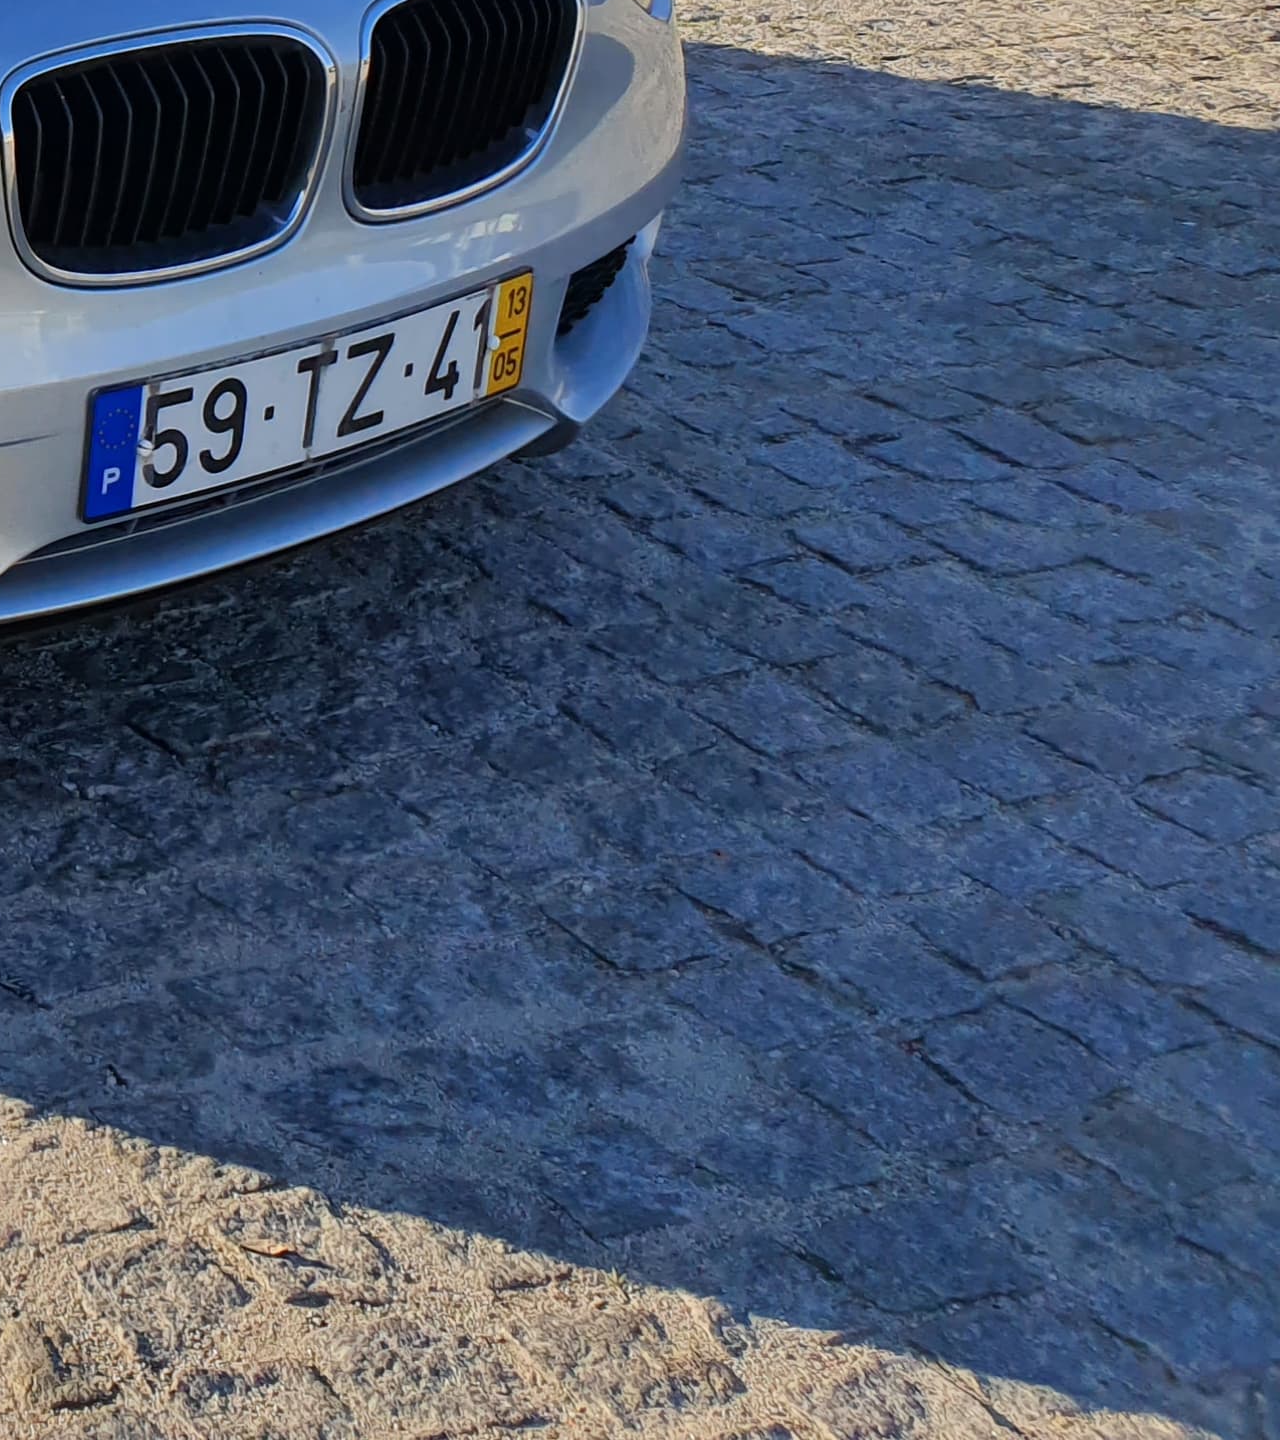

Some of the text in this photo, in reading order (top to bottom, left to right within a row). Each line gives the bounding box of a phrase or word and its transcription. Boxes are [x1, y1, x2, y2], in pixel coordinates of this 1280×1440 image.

[508, 286, 527, 319] 13
[493, 346, 519, 382] 05
[101, 467, 121, 495] P
